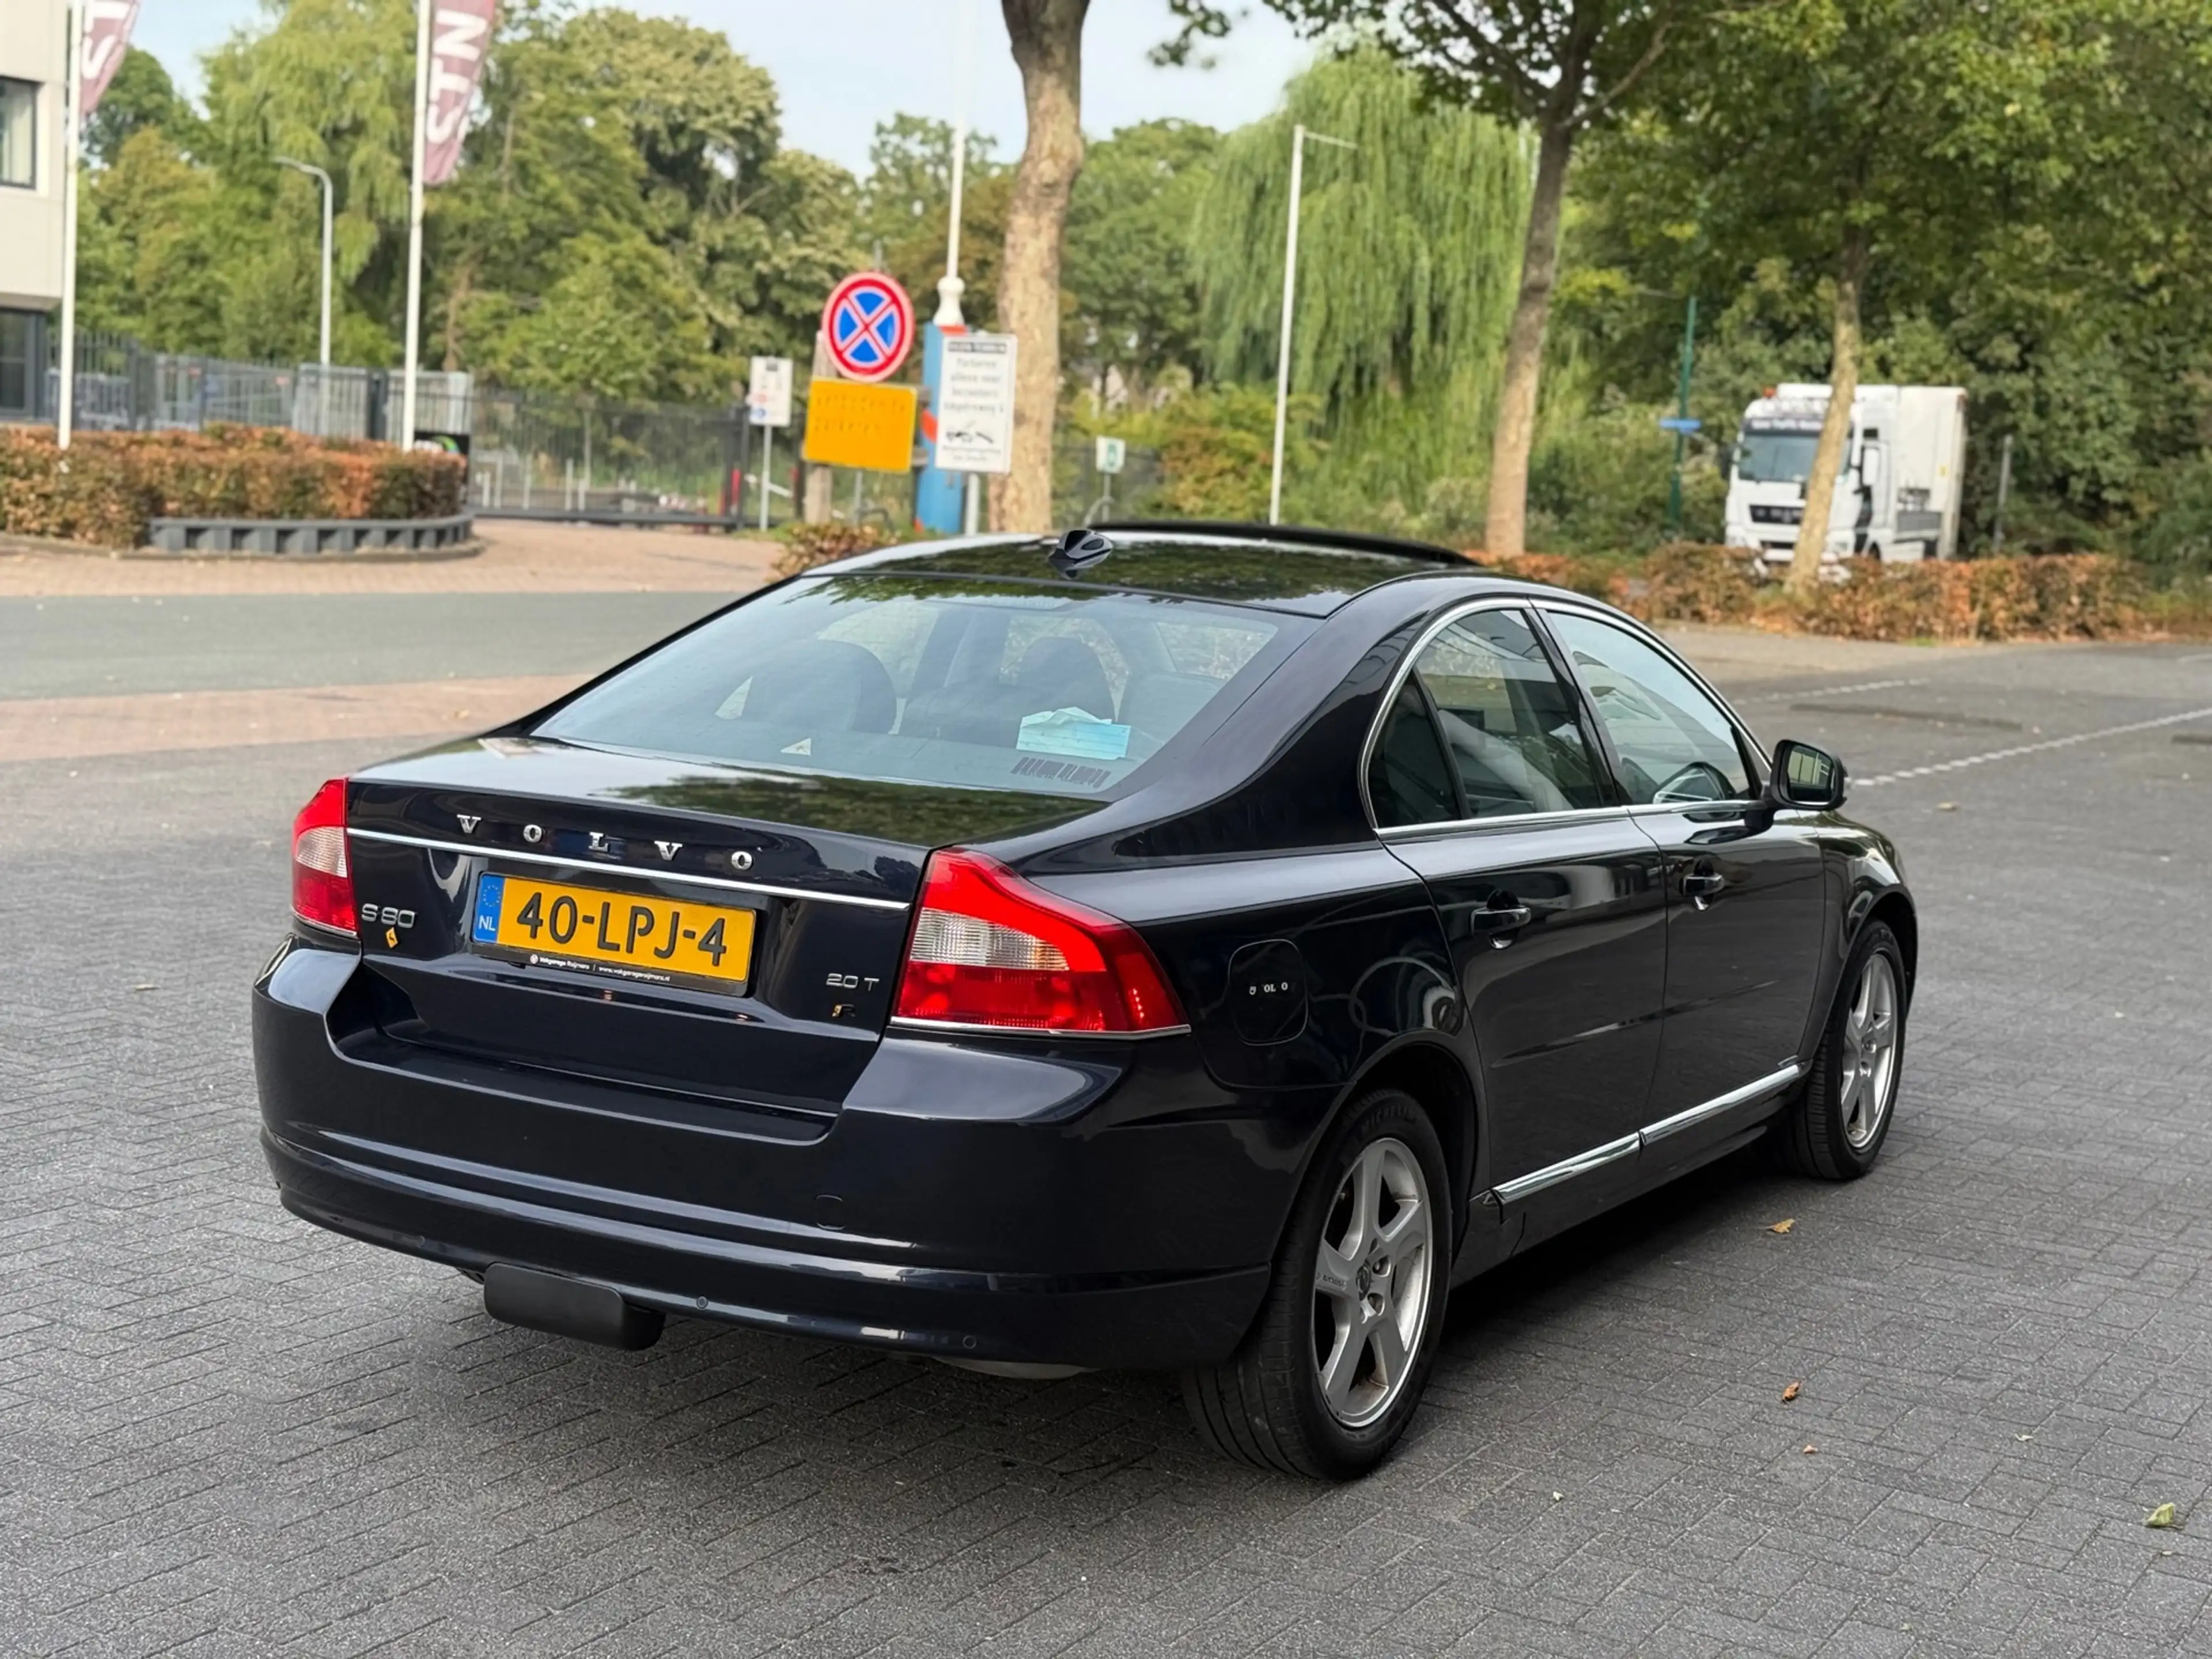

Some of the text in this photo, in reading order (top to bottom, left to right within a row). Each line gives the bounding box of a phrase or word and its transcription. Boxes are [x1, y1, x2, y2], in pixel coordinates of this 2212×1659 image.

[457, 814, 754, 871] VOLVO
[361, 903, 416, 929] S80
[479, 914, 496, 931] NL
[517, 892, 726, 967] 40-LPJ-4
